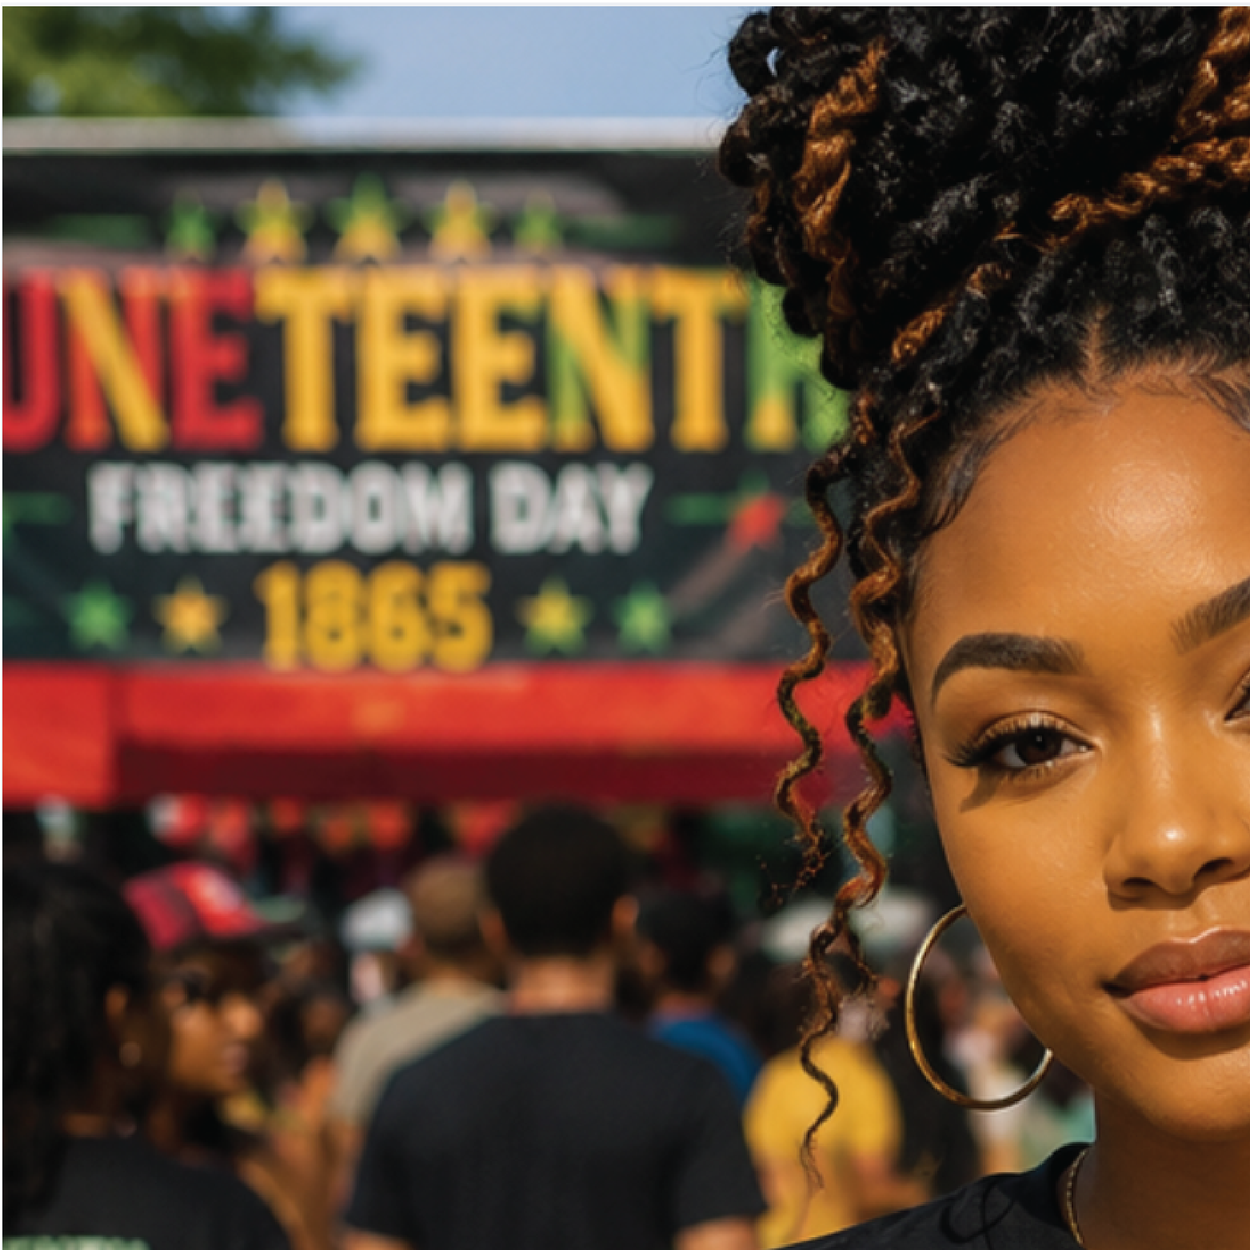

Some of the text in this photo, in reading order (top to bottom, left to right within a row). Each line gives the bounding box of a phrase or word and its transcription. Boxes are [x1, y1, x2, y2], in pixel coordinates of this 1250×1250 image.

[86, 460, 655, 555] FREEDOM DAY
[255, 559, 493, 674] 1865
